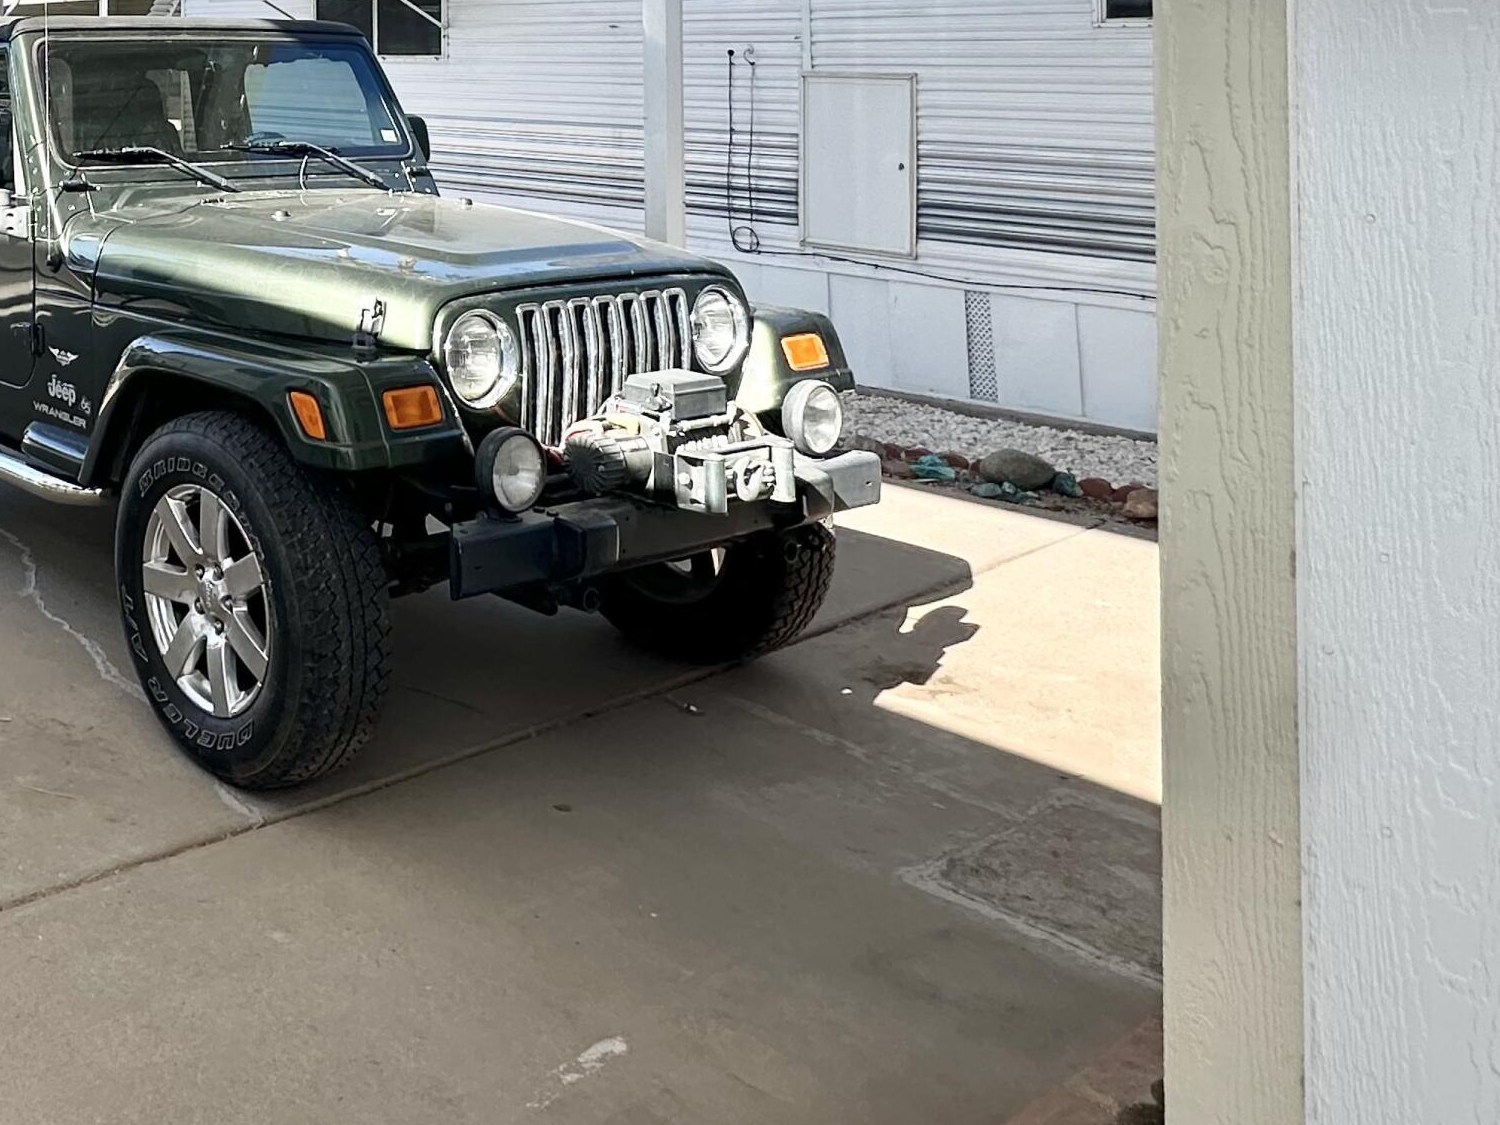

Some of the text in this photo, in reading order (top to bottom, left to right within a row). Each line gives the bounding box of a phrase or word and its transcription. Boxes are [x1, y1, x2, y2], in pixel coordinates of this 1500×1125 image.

[47, 374, 76, 407] Jeep
[33, 400, 87, 429] WRANGLER
[147, 676, 254, 751] DUELER
